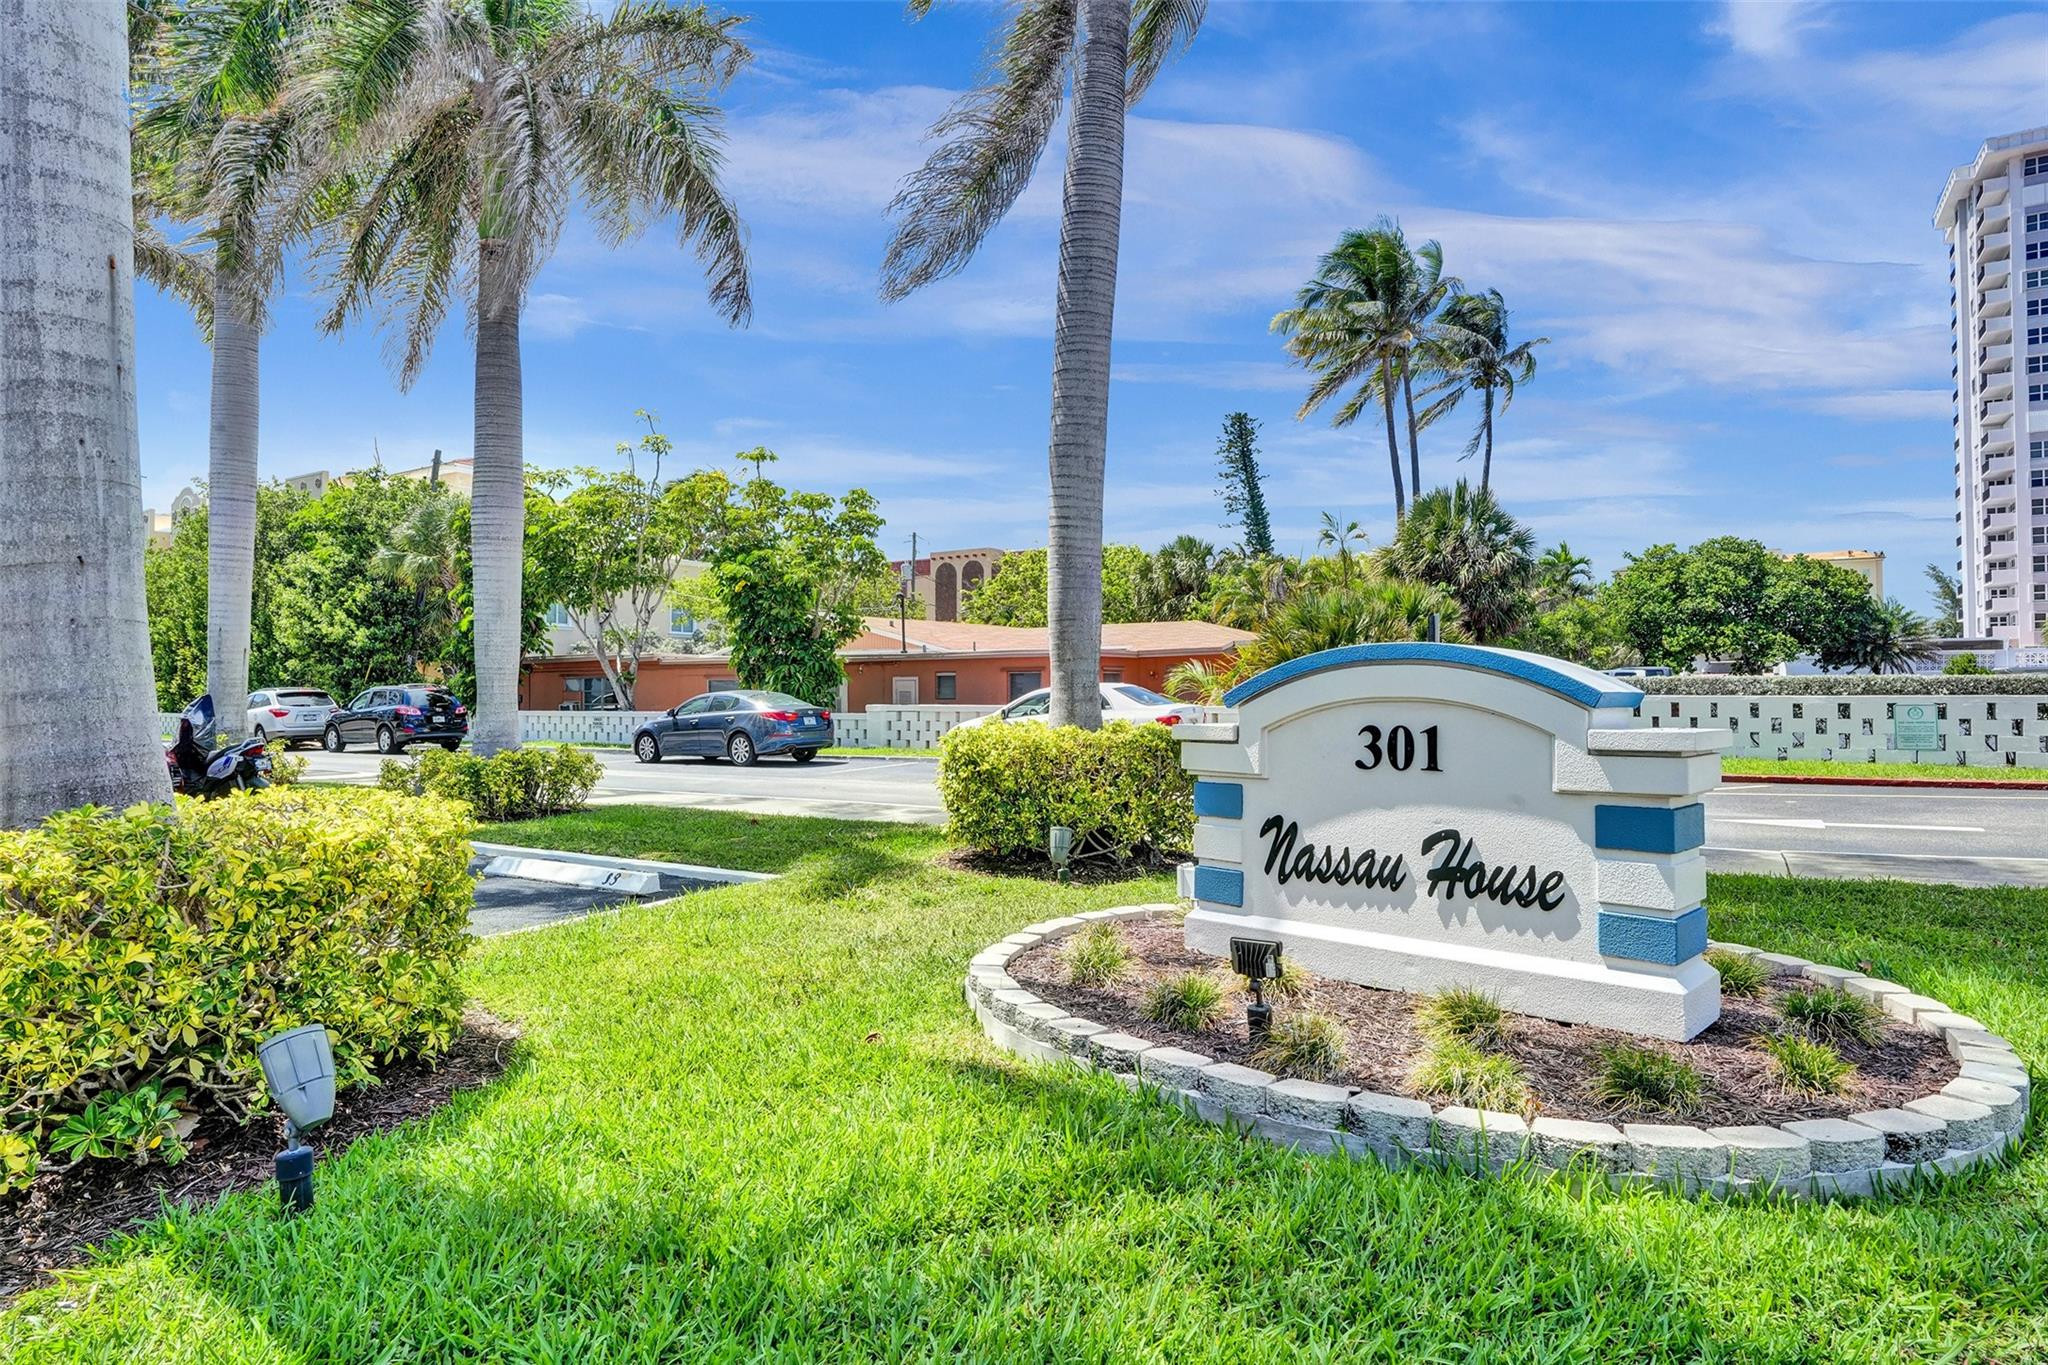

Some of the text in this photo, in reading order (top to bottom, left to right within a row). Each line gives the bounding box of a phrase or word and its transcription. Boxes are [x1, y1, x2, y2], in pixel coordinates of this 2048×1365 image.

[1355, 724, 1443, 772] 301
[1259, 814, 1565, 912] Nassau House
